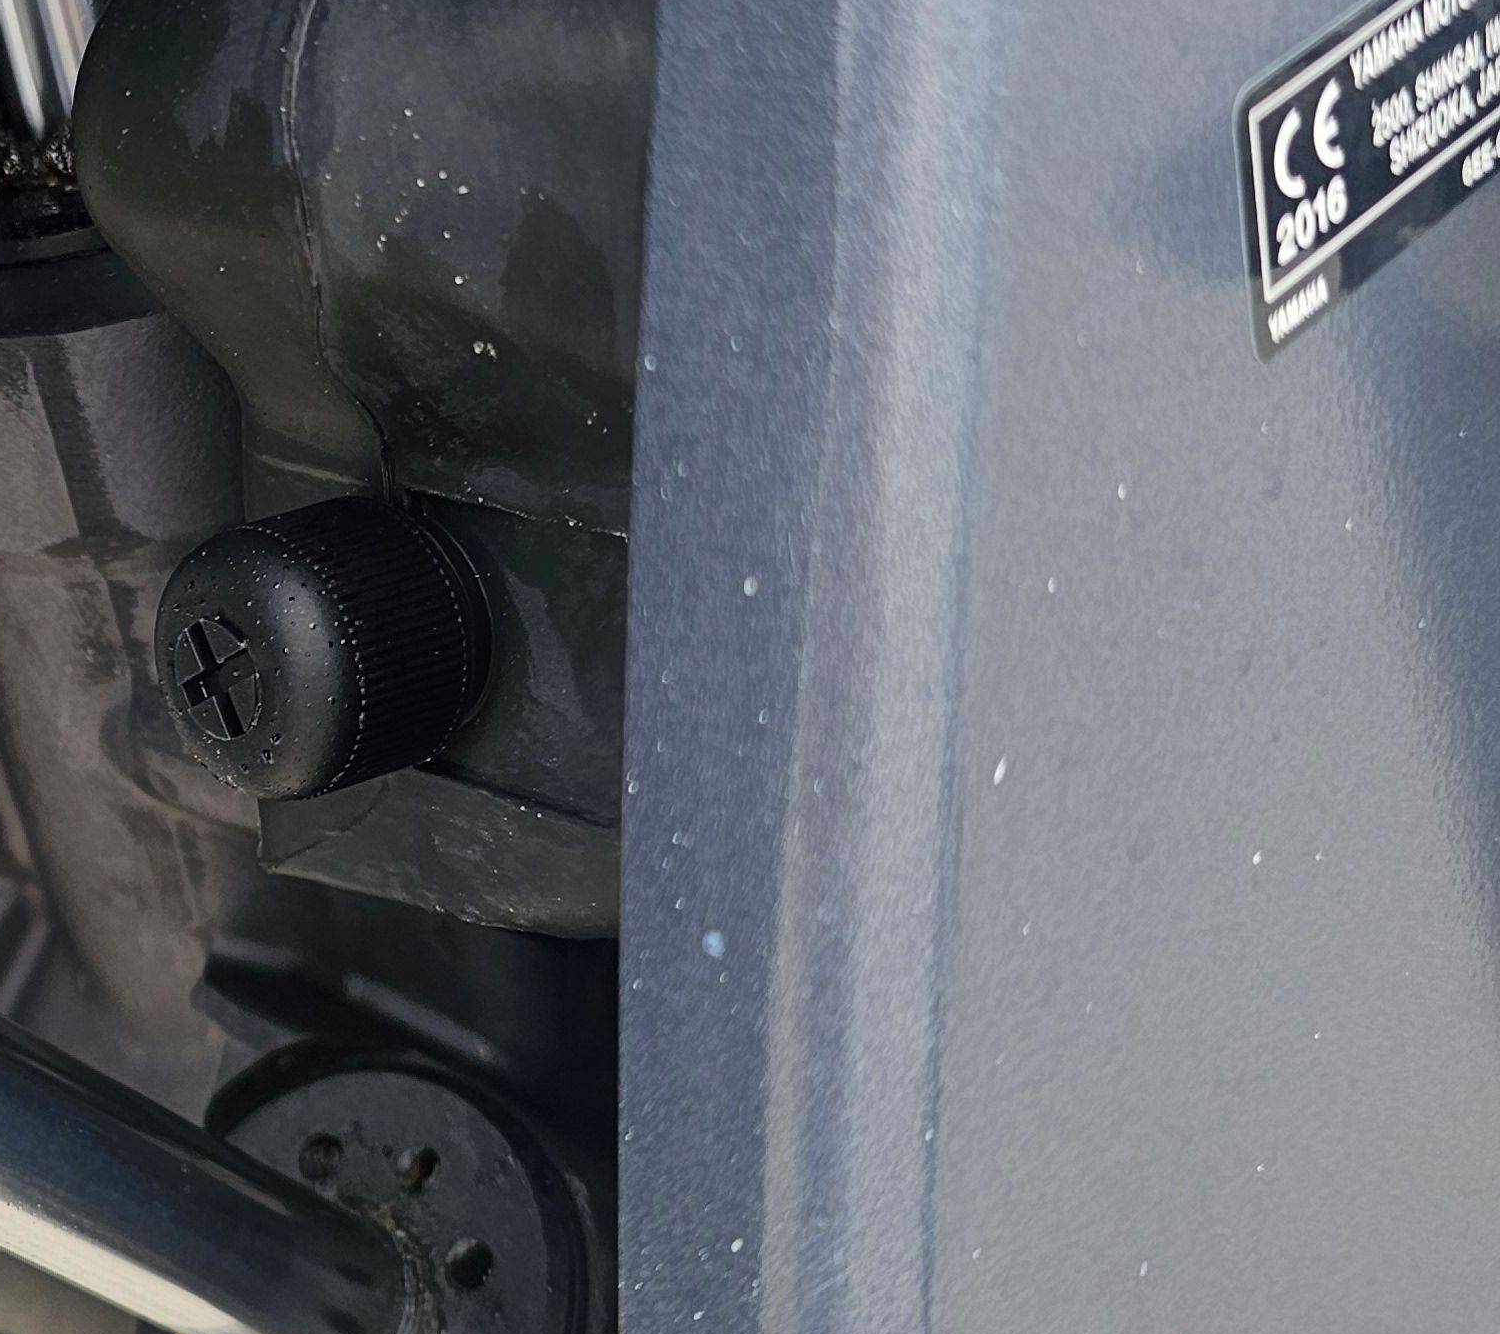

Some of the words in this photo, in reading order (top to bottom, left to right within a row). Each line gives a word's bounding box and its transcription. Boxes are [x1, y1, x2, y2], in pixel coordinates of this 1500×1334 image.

[1349, 7, 1425, 89] YAMAHA
[1276, 174, 1348, 267] 2016
[1267, 272, 1330, 344] YAMAHA
